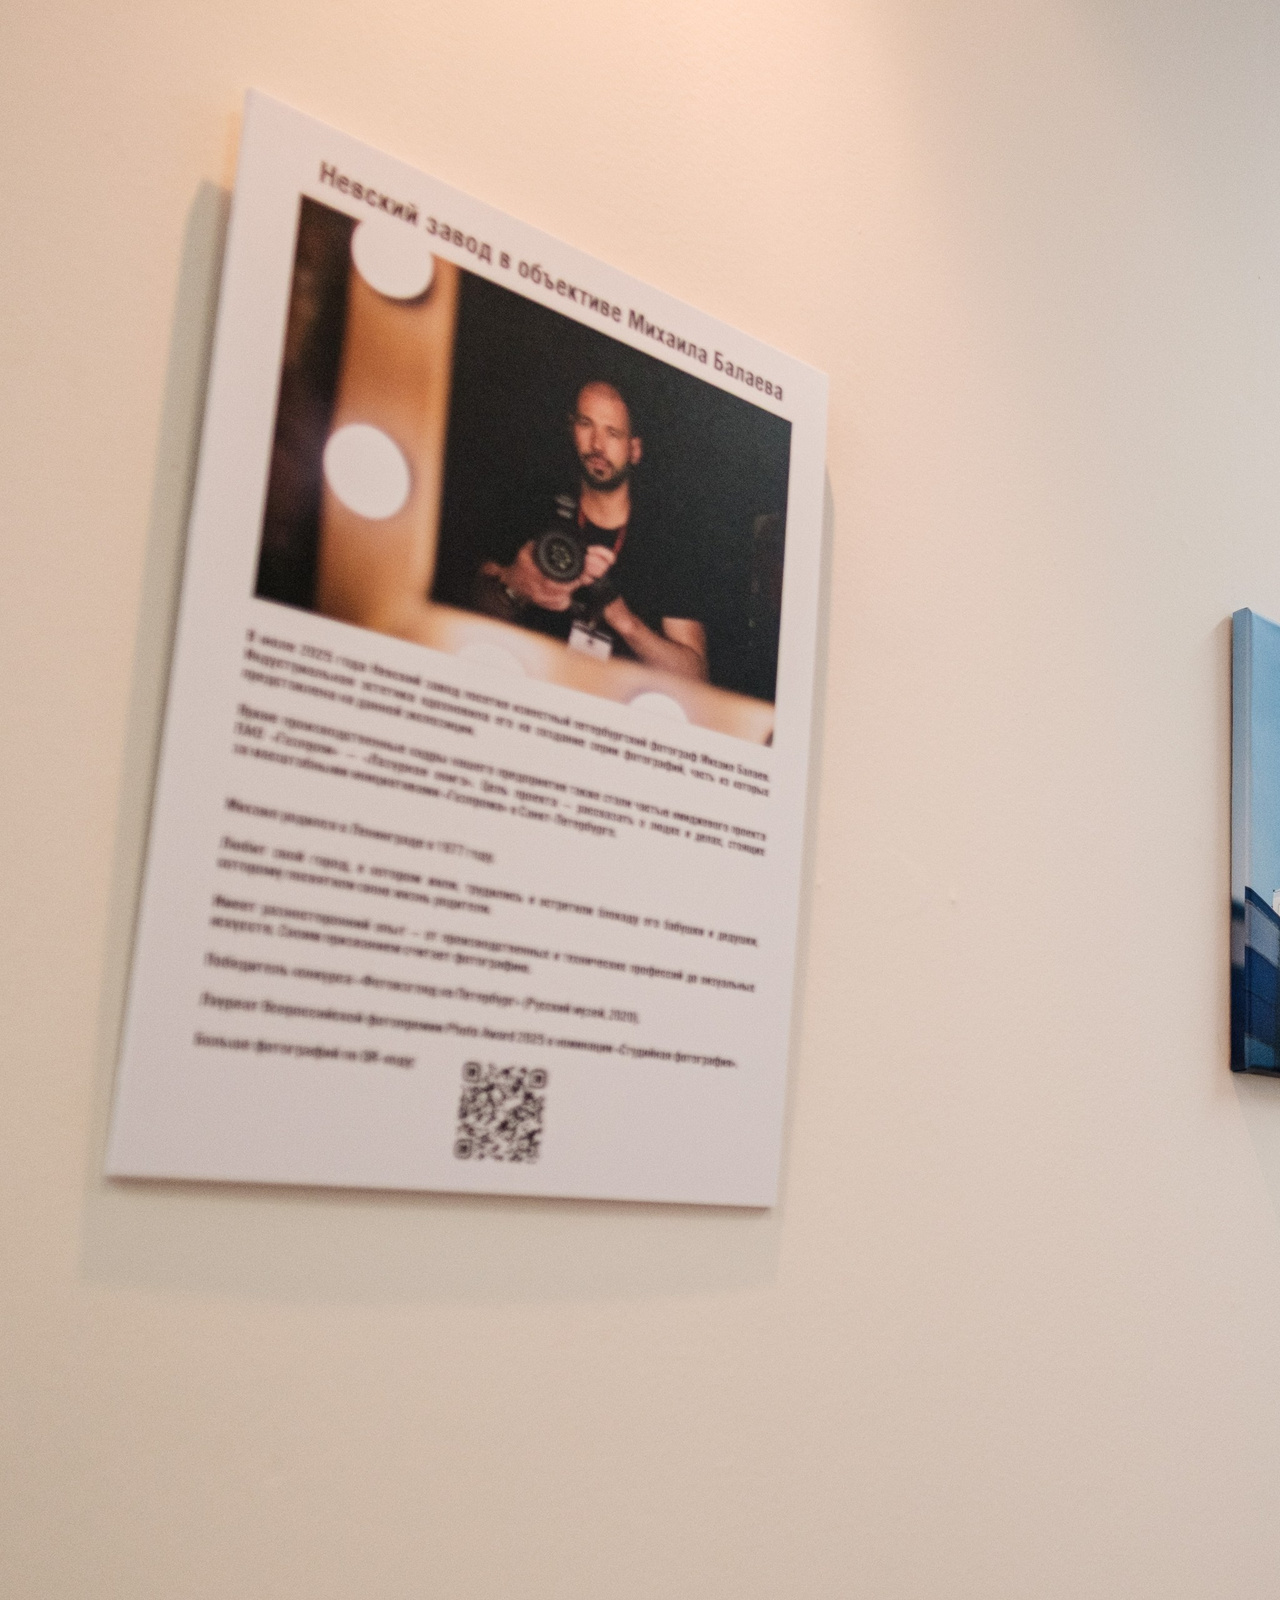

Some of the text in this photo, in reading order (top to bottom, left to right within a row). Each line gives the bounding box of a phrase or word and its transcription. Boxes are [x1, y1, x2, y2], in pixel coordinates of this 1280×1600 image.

[318, 158, 783, 400] Невский завод в объективе Михаила Балаева
